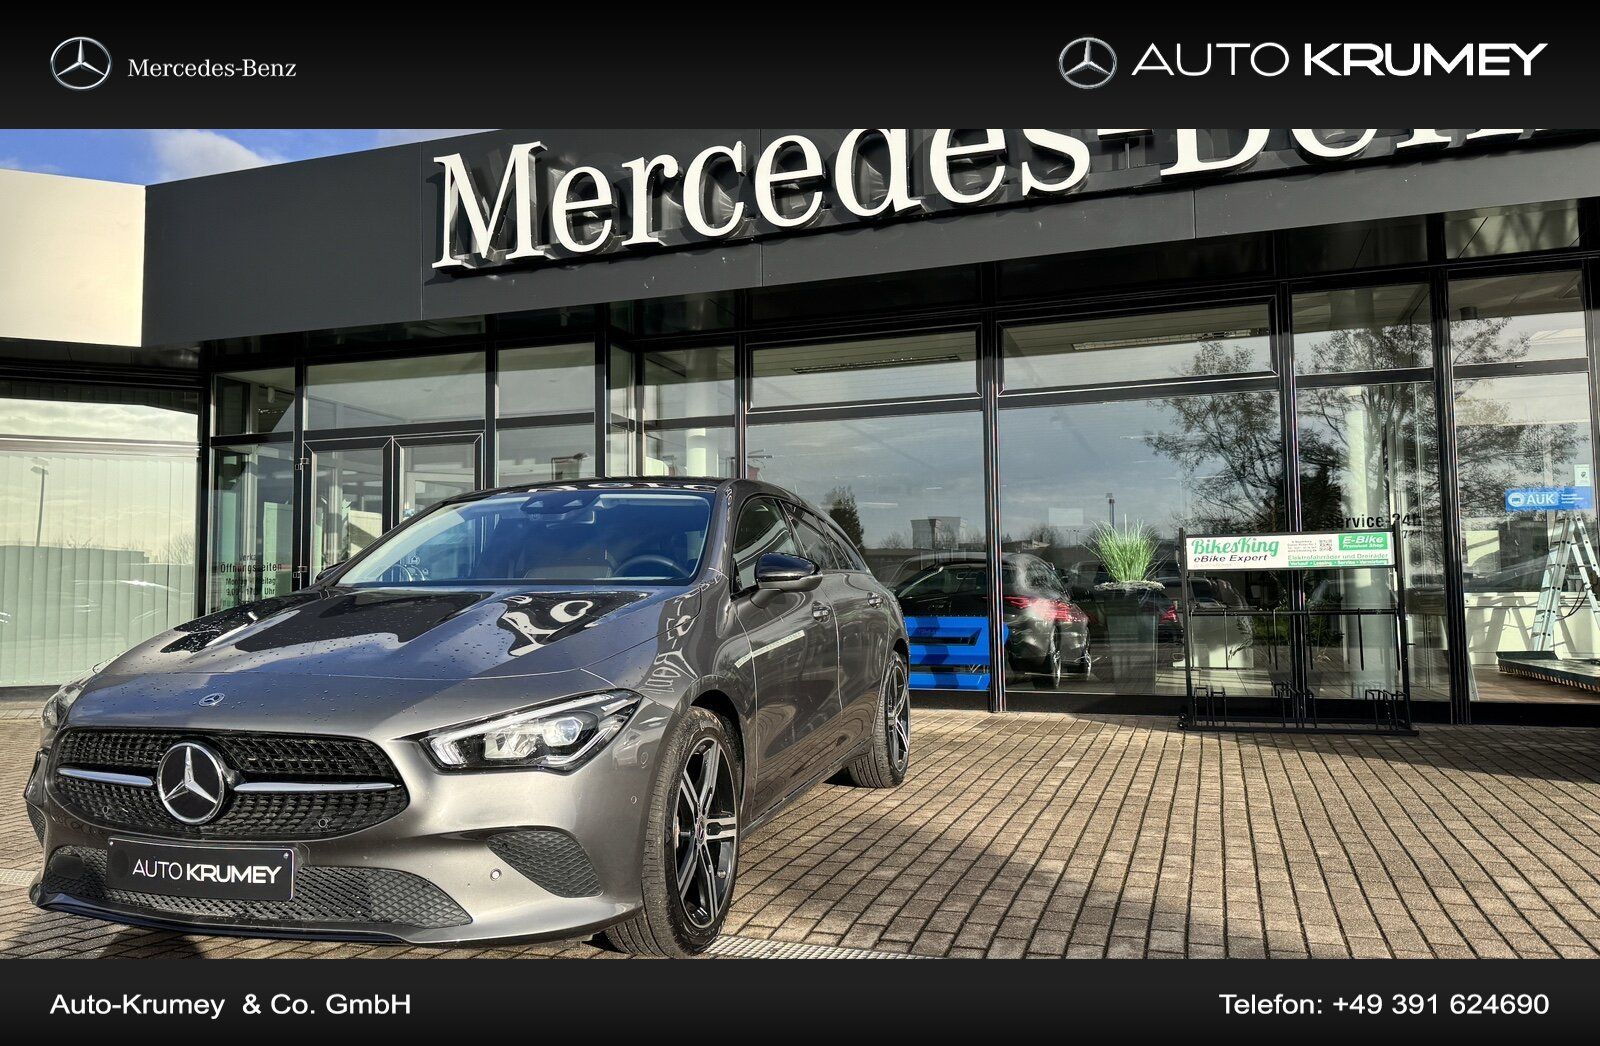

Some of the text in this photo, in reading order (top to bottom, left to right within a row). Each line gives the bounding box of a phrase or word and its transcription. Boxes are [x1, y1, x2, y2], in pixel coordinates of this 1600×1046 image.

[1526, 493, 1555, 505] AUK
[1342, 534, 1383, 544] E-Bike
[1192, 537, 1280, 557] BikesKing
[1193, 554, 1268, 563] eBike Expert
[132, 858, 283, 884] AUTO KRUMEY
